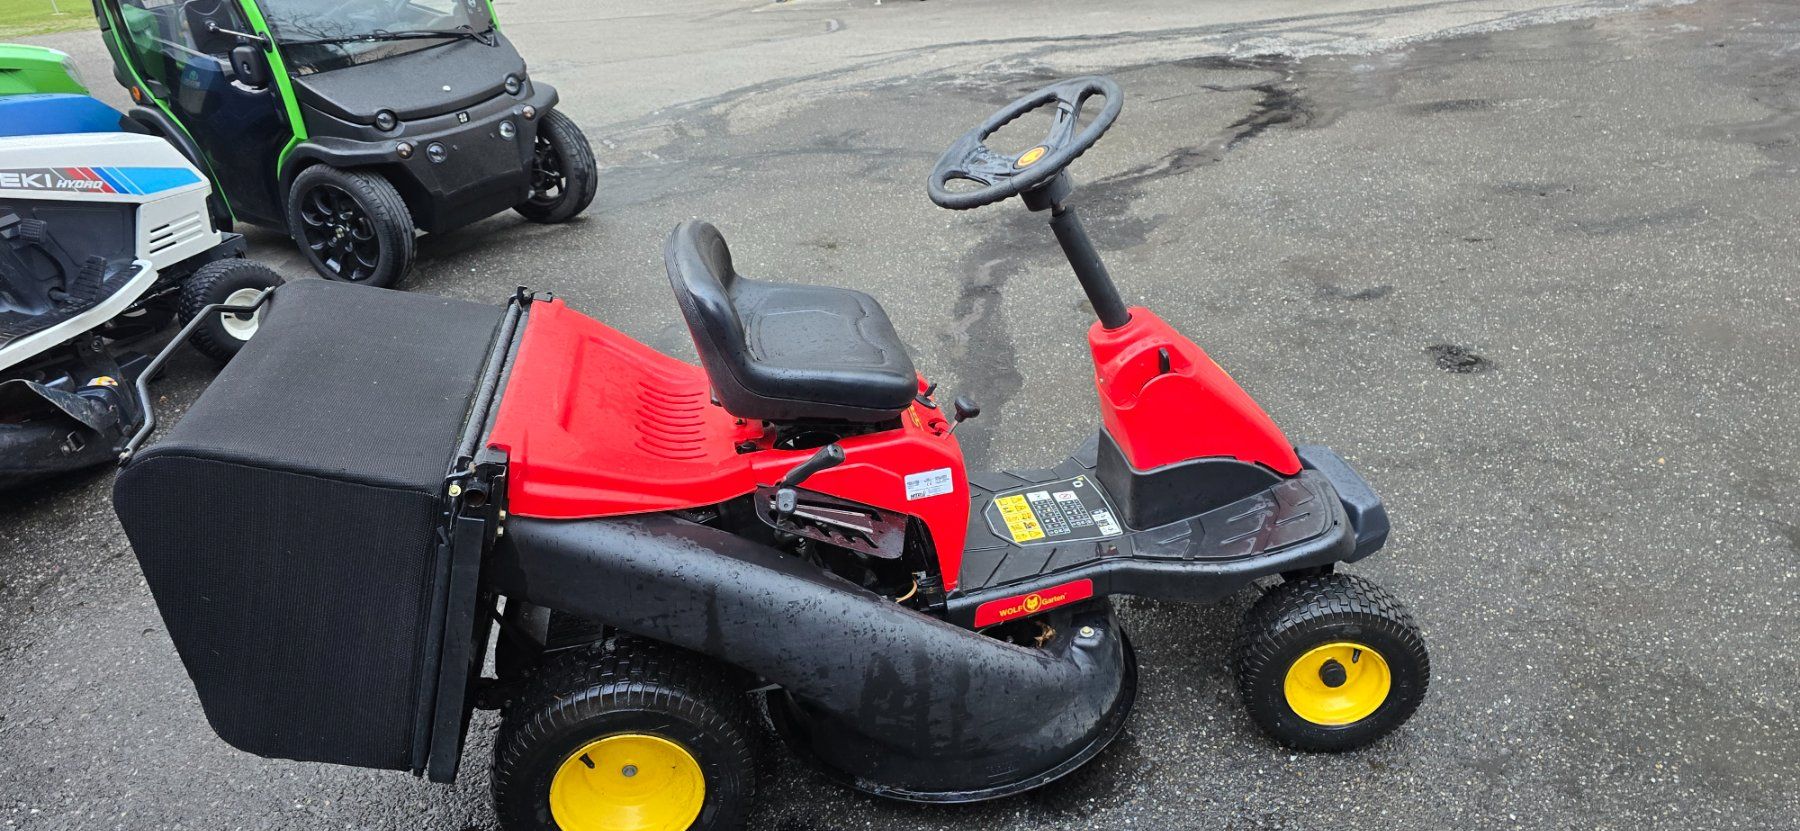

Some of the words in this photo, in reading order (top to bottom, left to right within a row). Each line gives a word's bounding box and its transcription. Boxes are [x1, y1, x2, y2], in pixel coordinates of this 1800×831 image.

[56, 179, 104, 189] HYDRO
[999, 605, 1023, 617] WOLF
[1041, 594, 1065, 605] Garten
